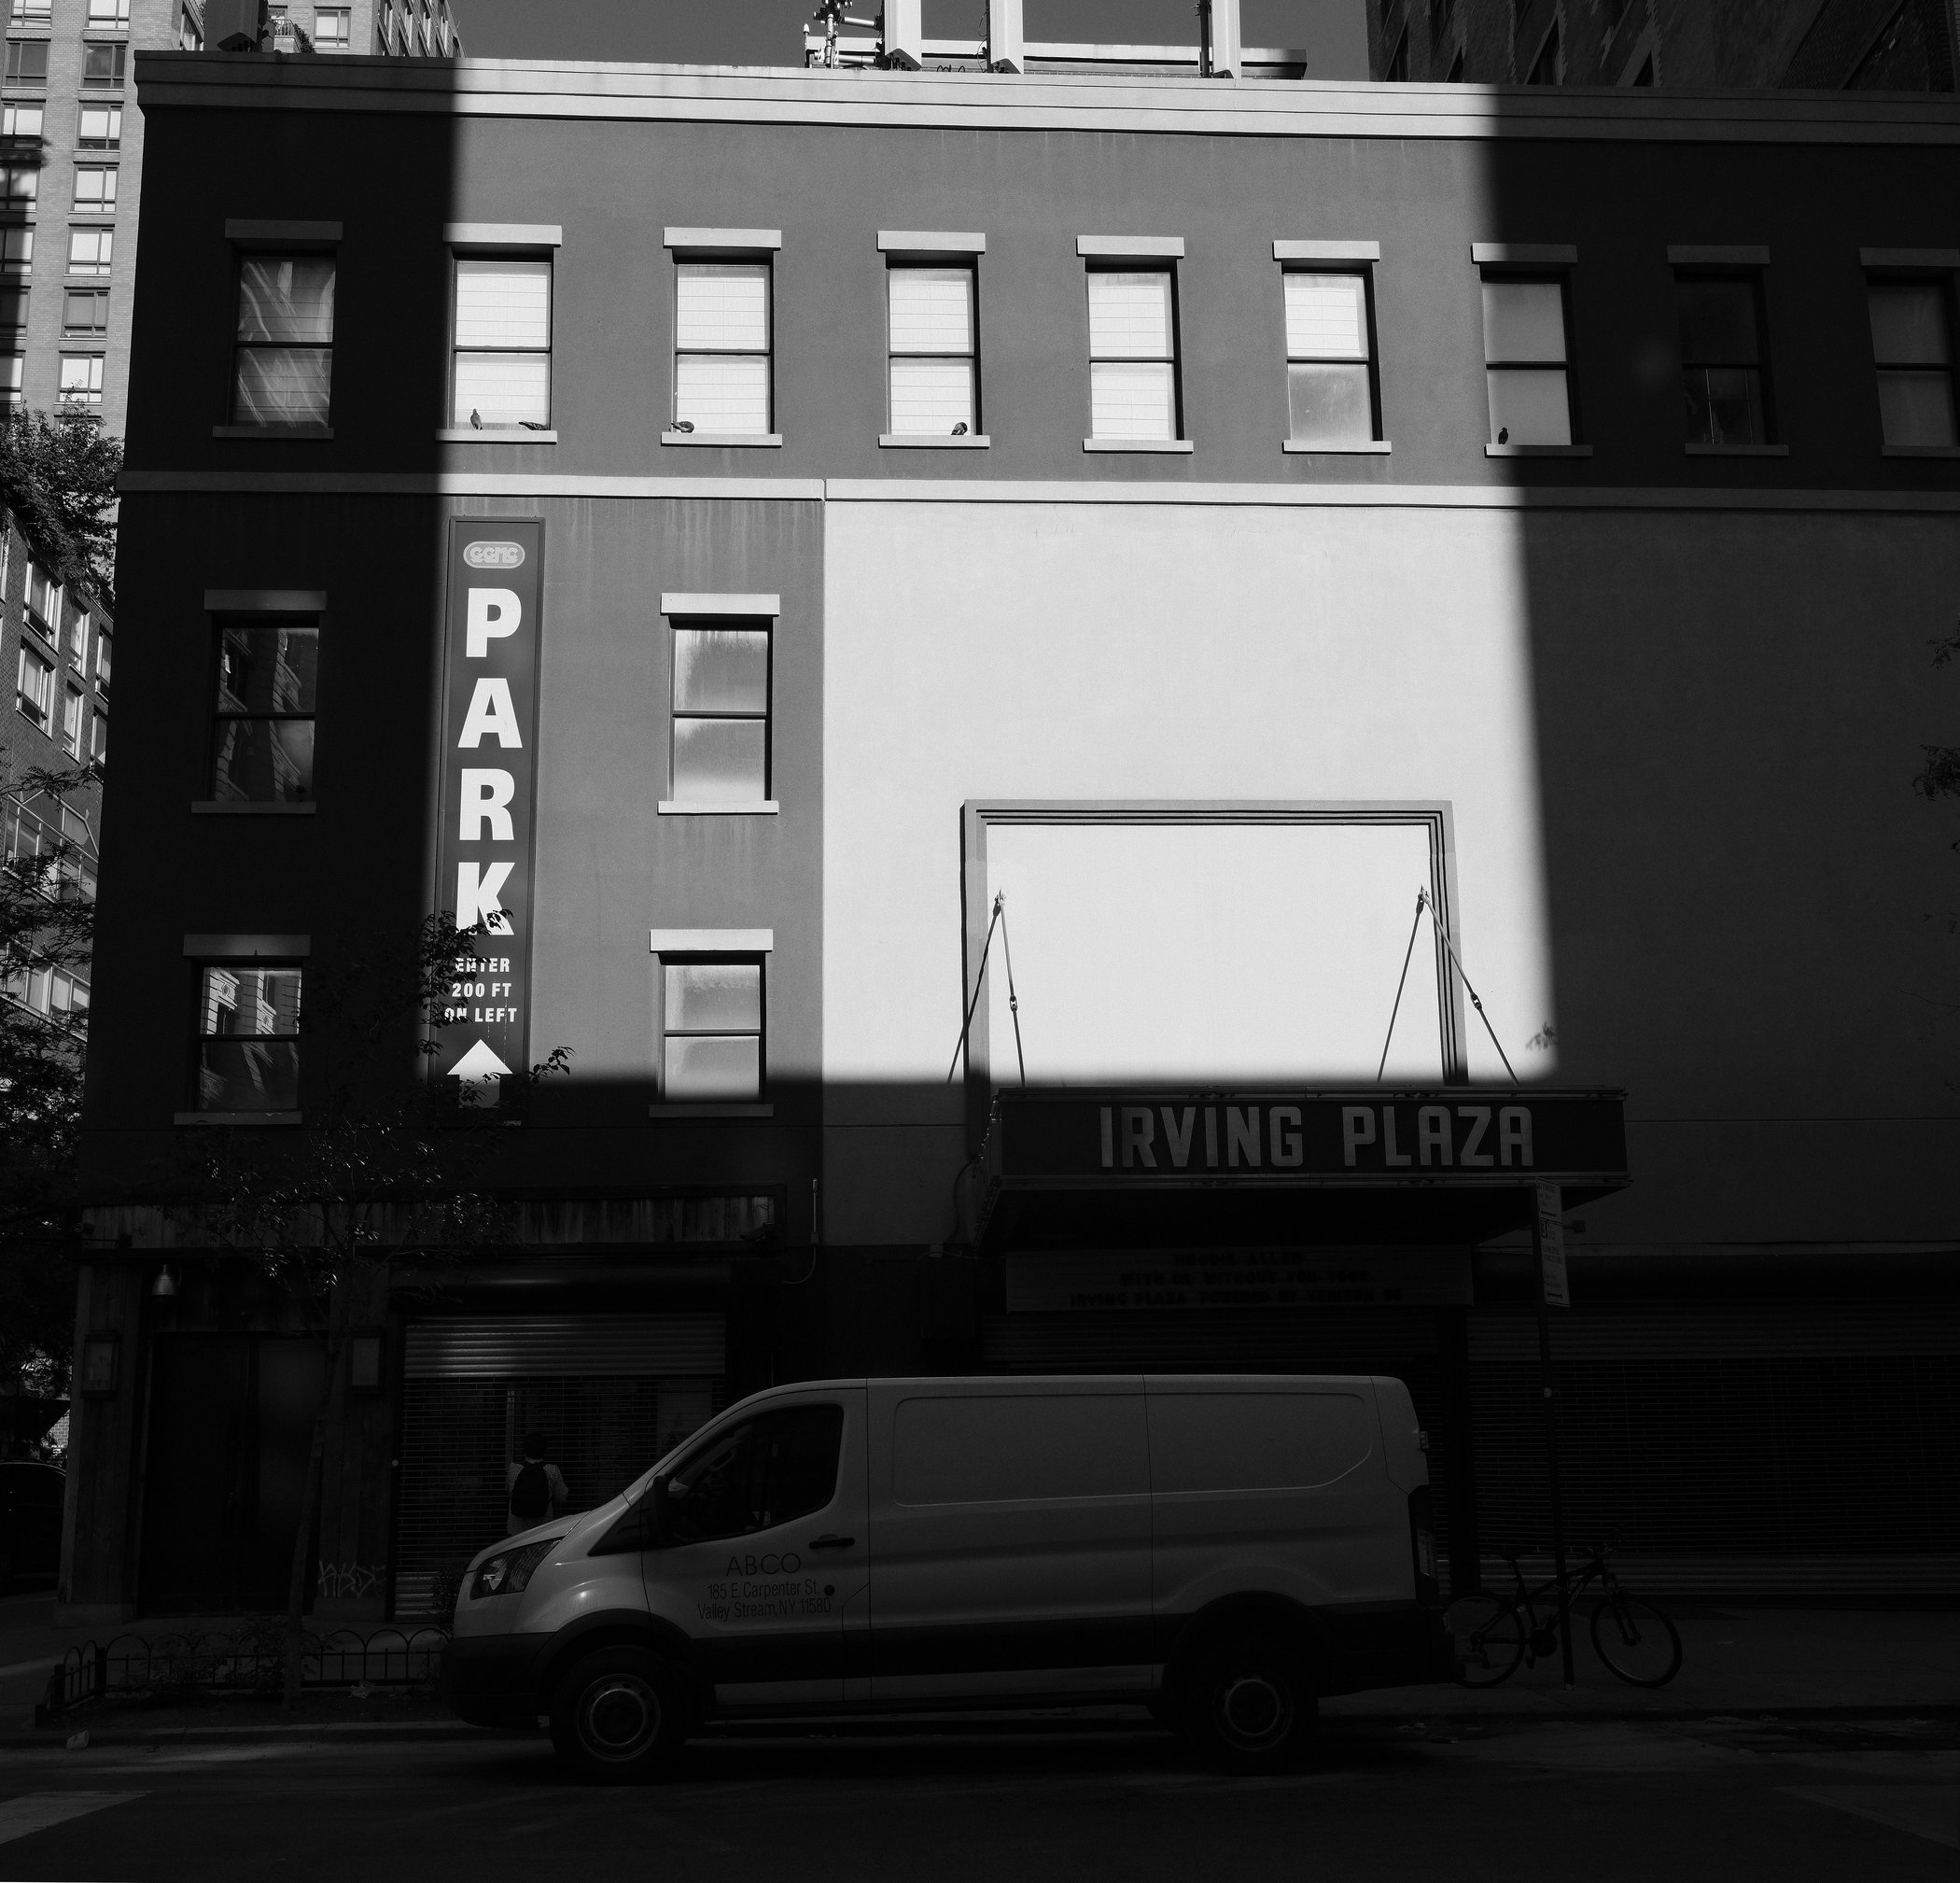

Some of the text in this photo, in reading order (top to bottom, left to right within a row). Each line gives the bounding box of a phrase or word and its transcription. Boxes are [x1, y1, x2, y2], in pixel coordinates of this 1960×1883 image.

[456, 587, 523, 935] PARK
[455, 957, 511, 973] ENTER
[452, 982, 512, 998] 200 FT
[444, 1007, 517, 1022] ON LEFT
[1099, 1104, 1534, 1168] IRVING PLAZA
[1121, 1272, 1165, 1286] WITH
[1203, 1271, 1276, 1286] WITHOUT
[1071, 1291, 1127, 1306] IRVING
[1135, 1291, 1188, 1305] PLAZA
[726, 1553, 802, 1577] ABCO
[707, 1583, 727, 1600] 185
[743, 1580, 802, 1600] Carpenter
[697, 1603, 731, 1623] Valley
[799, 1596, 831, 1615] 11580
